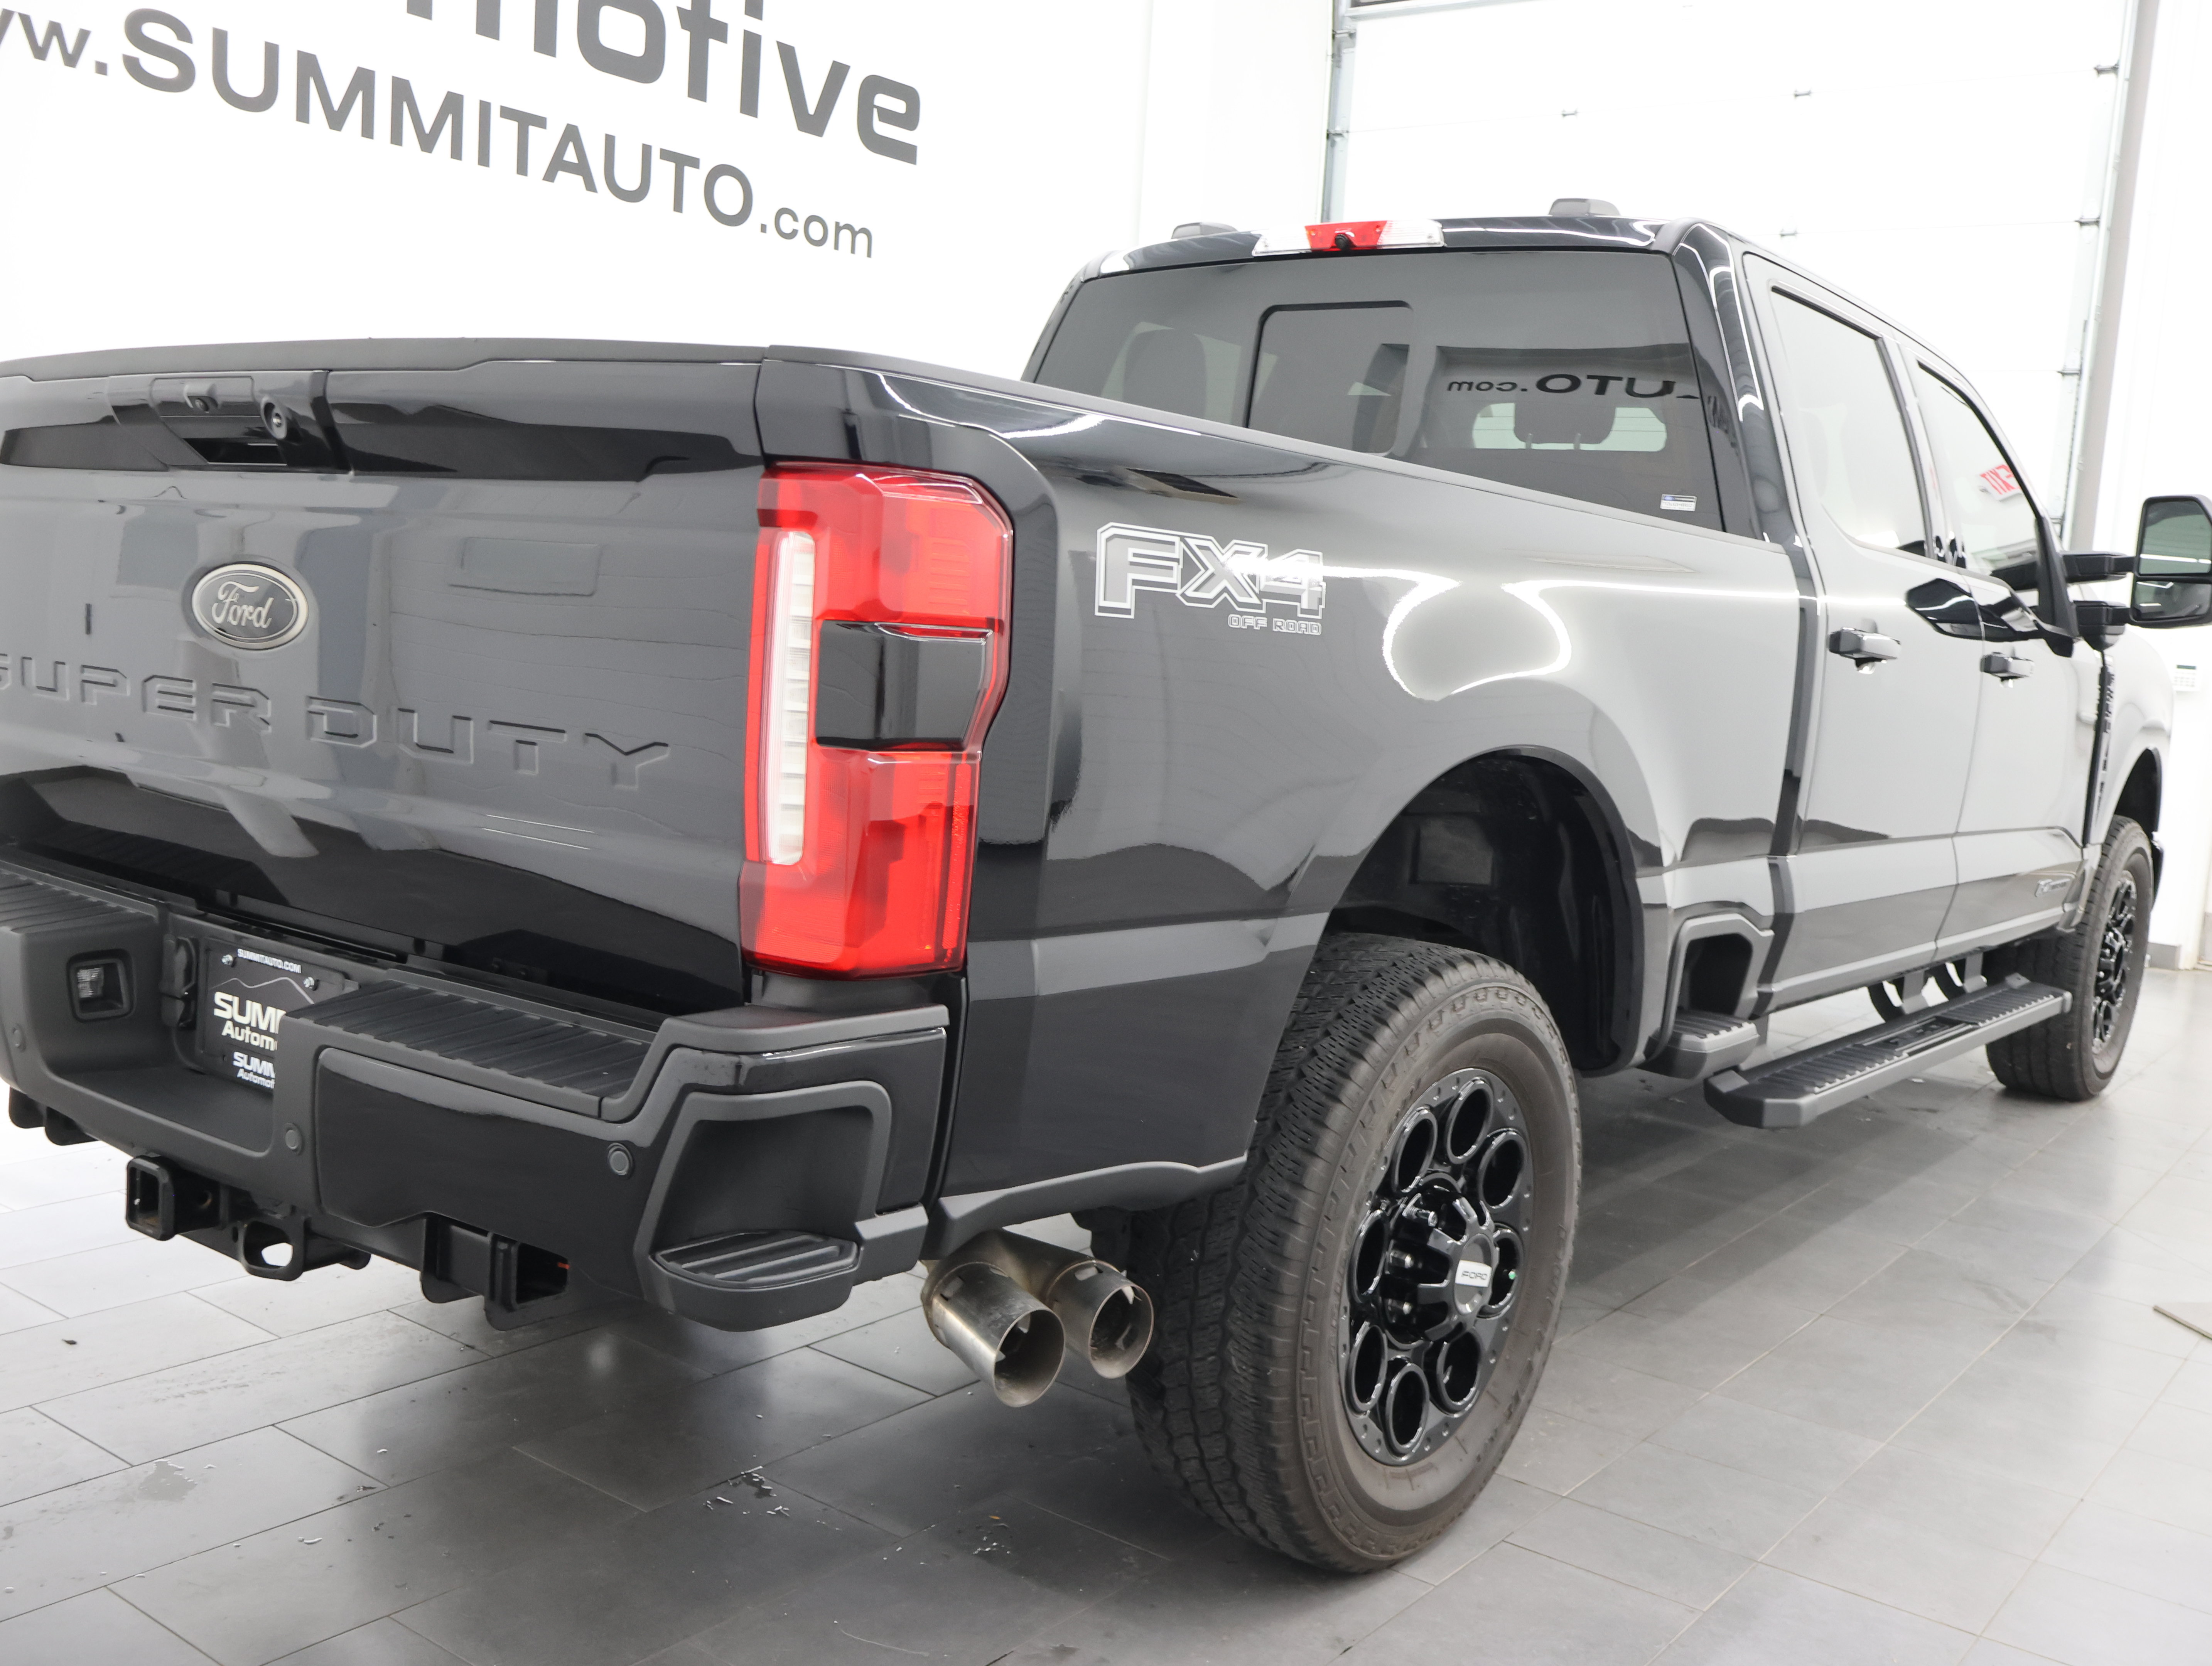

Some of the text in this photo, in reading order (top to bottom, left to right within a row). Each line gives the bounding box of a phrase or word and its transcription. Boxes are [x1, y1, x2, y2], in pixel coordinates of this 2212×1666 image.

[1095, 522, 1326, 619] FX4
[211, 580, 275, 629] Ford
[1228, 614, 1322, 635] OFF ROAD
[0, 653, 671, 789] UPER DUTY
[237, 948, 302, 974] SUMMITAUTO.COM
[221, 1020, 278, 1051] Autom
[1461, 1270, 1487, 1280] FORD
